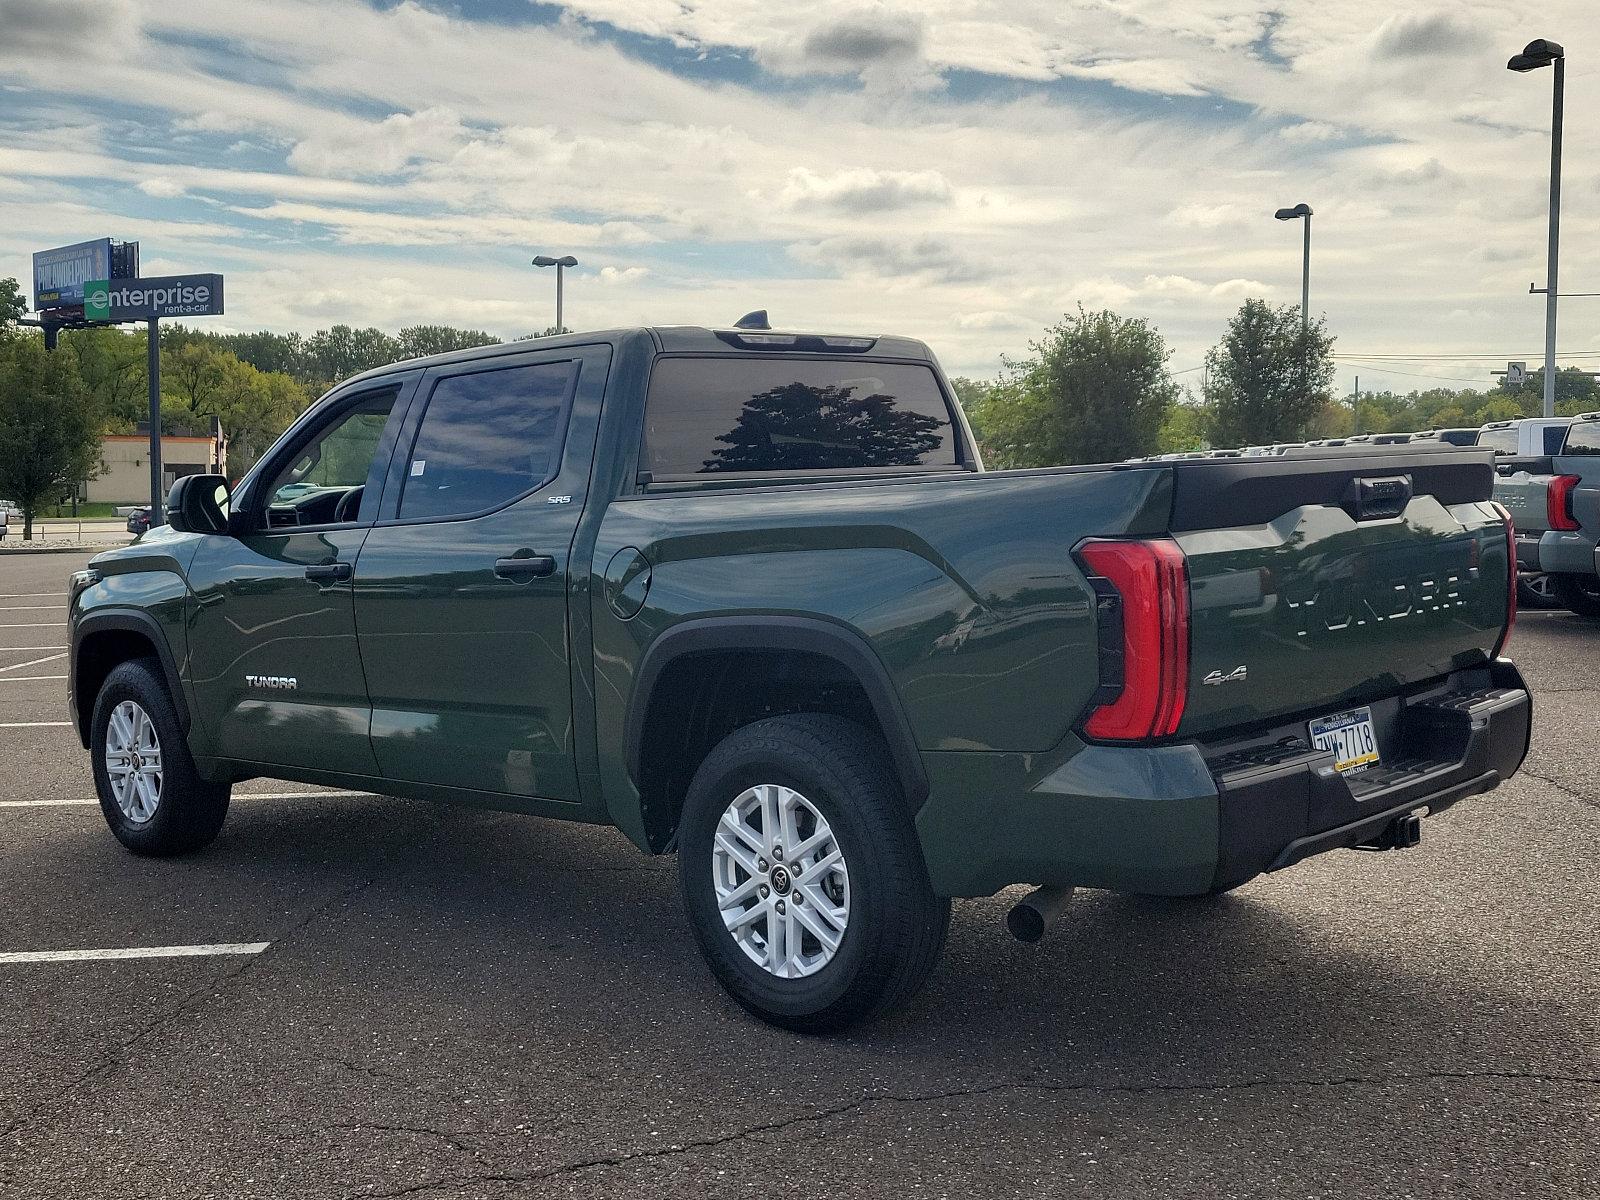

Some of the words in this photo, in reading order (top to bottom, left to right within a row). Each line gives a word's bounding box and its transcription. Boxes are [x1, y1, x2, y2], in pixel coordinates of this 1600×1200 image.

[85, 282, 210, 310] enterprise
[164, 304, 208, 314] rent-a-car
[547, 495, 572, 504] SR5
[245, 675, 297, 690] TUNDRA
